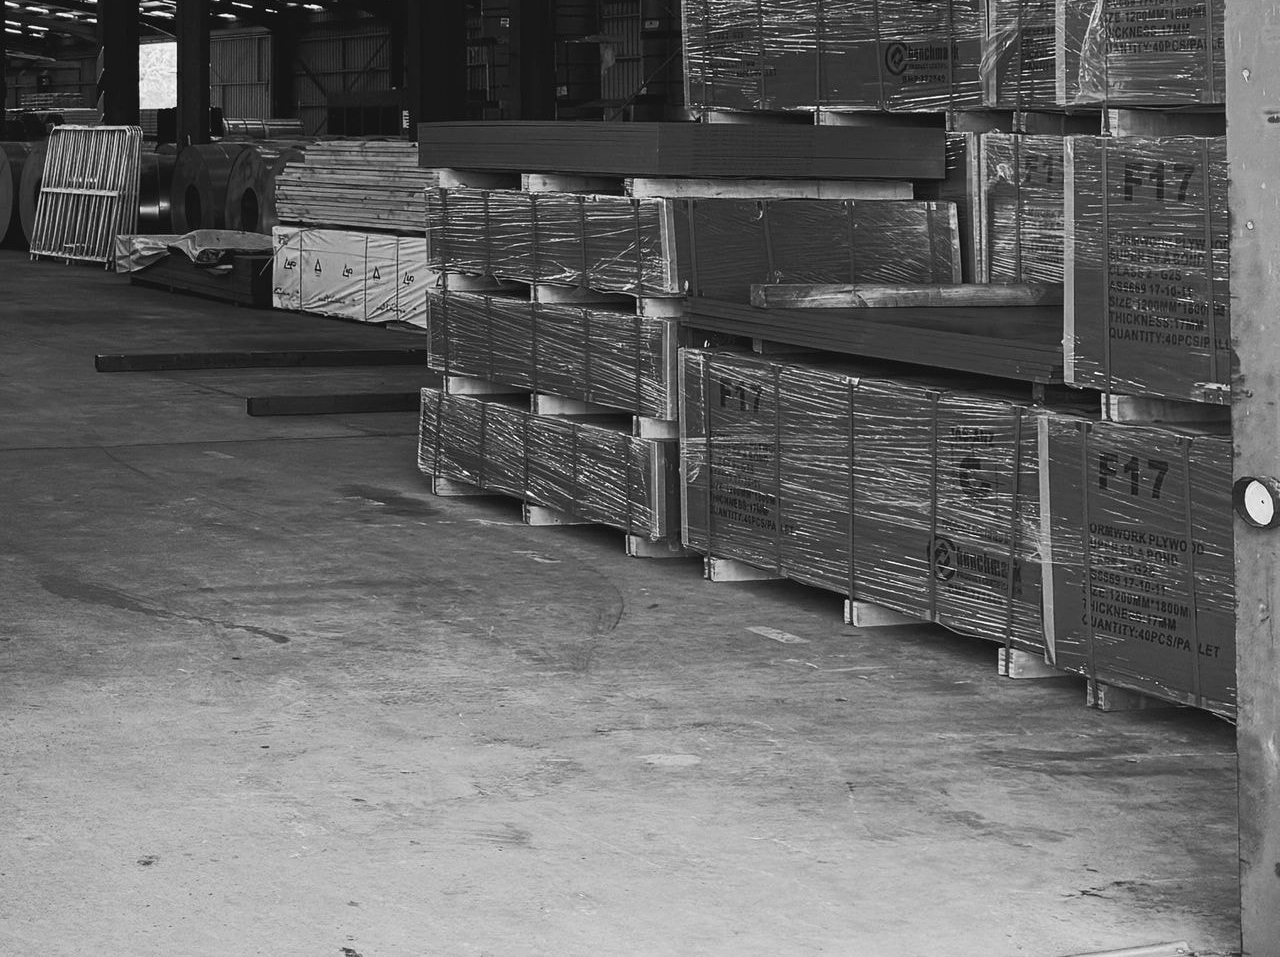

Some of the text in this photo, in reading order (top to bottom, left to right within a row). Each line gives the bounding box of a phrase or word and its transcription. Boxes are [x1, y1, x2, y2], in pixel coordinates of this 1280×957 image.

[907, 43, 959, 61] benchmak
[1124, 161, 1194, 202] F17
[1108, 264, 1145, 279] CLASS
[1098, 451, 1169, 499] F17
[1089, 523, 1146, 545] ORMWORK
[956, 546, 1022, 583] benchmak
